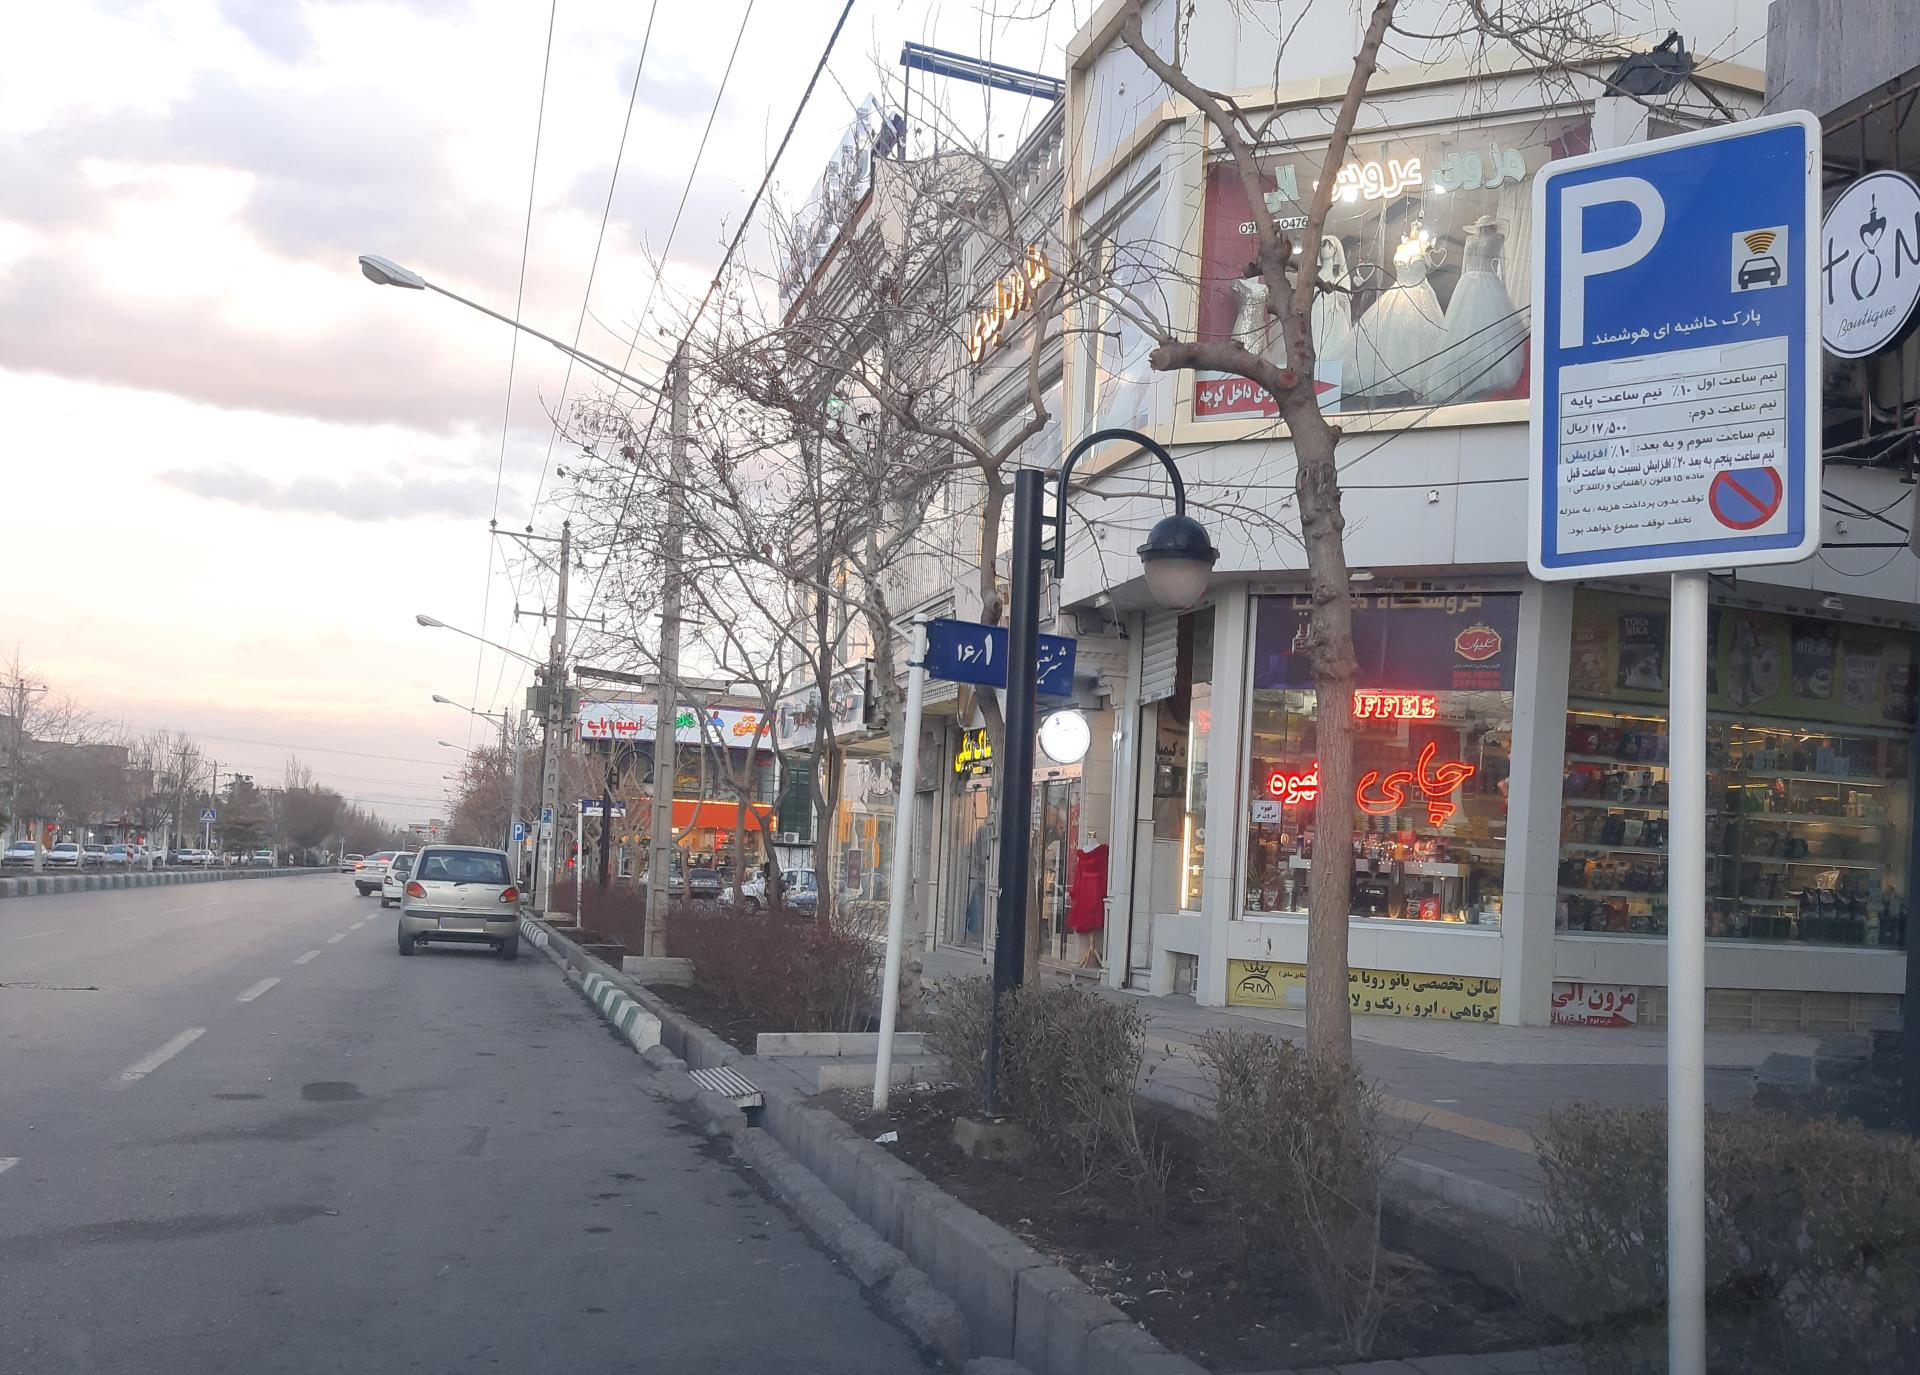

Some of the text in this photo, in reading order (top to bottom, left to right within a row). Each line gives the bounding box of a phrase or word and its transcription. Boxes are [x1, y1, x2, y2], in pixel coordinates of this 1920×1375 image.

[1432, 139, 1526, 191] مزون
[1559, 177, 1665, 349] P
[1592, 309, 1761, 345] پارک حاشیه ای هوشمند
[1837, 305, 1896, 338] Boutique
[1697, 377, 1715, 391] اول
[1719, 374, 1756, 386] ساعت
[1759, 371, 1778, 387] نیم
[1200, 384, 1225, 408] کوچه
[1227, 383, 1252, 405] داخل
[1597, 391, 1639, 404] ساعت
[1643, 389, 1662, 405] نیم
[1570, 396, 1593, 411] پایه
[1718, 402, 1756, 415] ساعت
[1759, 399, 1777, 415] نیم
[1566, 424, 1588, 436] ریال
[1716, 431, 1754, 442] ساعت
[1757, 427, 1775, 442] نیم
[1662, 440, 1674, 449] به
[1687, 435, 1713, 449] سوم
[1565, 448, 1608, 463] افزایش
[1688, 457, 1702, 468] بعد
[1704, 456, 1713, 467] به
[1734, 452, 1760, 463] ساعت
[1762, 450, 1775, 466] نیم
[1607, 465, 1616, 476] به
[1617, 462, 1641, 475] نسبت
[1643, 458, 1671, 475] افزایش
[1713, 456, 1733, 471] پنجم
[1566, 468, 1580, 483] قبل
[1582, 465, 1606, 478] ساعت
[1685, 474, 1705, 482] ماده
[1613, 479, 1647, 491] راهنمایی
[1649, 476, 1672, 486] قانون
[1597, 503, 1620, 512] هزینه
[1623, 501, 1655, 511] پرداخت
[1657, 498, 1679, 508] بدون
[1681, 496, 1704, 504] توقف
[1586, 523, 1612, 533] خواهد
[1614, 522, 1639, 534] ممنوع
[1641, 518, 1665, 527] توقف
[1673, 517, 1692, 525] تخلف
[1354, 694, 1436, 719] FFEE
[1270, 762, 1318, 804] هوه
[1356, 742, 1475, 827] چای
[515, 824, 523, 839] P
[1361, 971, 1386, 989] رویا
[1390, 972, 1410, 988] بانو
[1413, 975, 1464, 993] تخصصی
[1467, 979, 1498, 996] سالن
[1242, 982, 1270, 994] RM
[1375, 996, 1401, 1014] رنگ
[1588, 986, 1635, 1011] مزون
[1364, 1000, 1371, 1013] و
[1414, 1000, 1437, 1019] ابرو
[1450, 1005, 1497, 1022] کوتاهی
